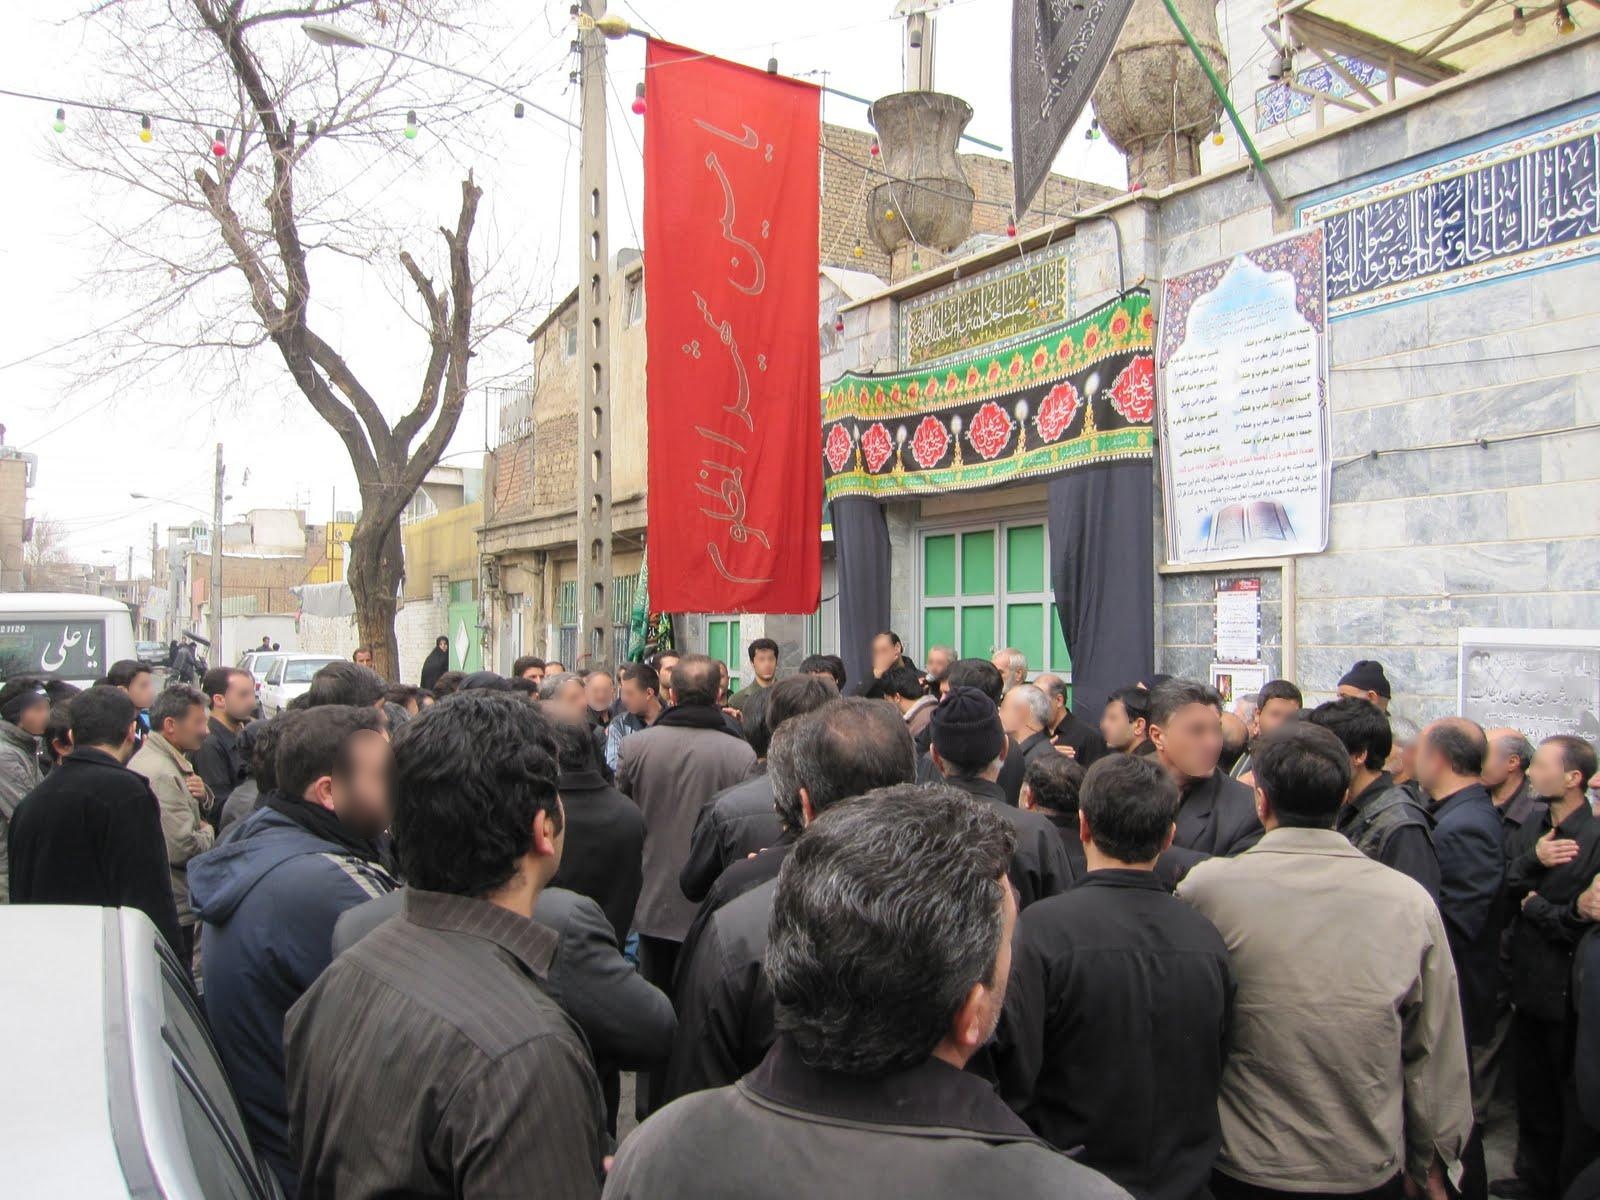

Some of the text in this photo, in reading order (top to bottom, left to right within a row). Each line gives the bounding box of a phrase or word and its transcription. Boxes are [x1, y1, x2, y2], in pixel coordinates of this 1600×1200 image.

[692, 117, 773, 162] یا
[704, 151, 770, 296] حسین
[41, 625, 98, 672] یا علی
